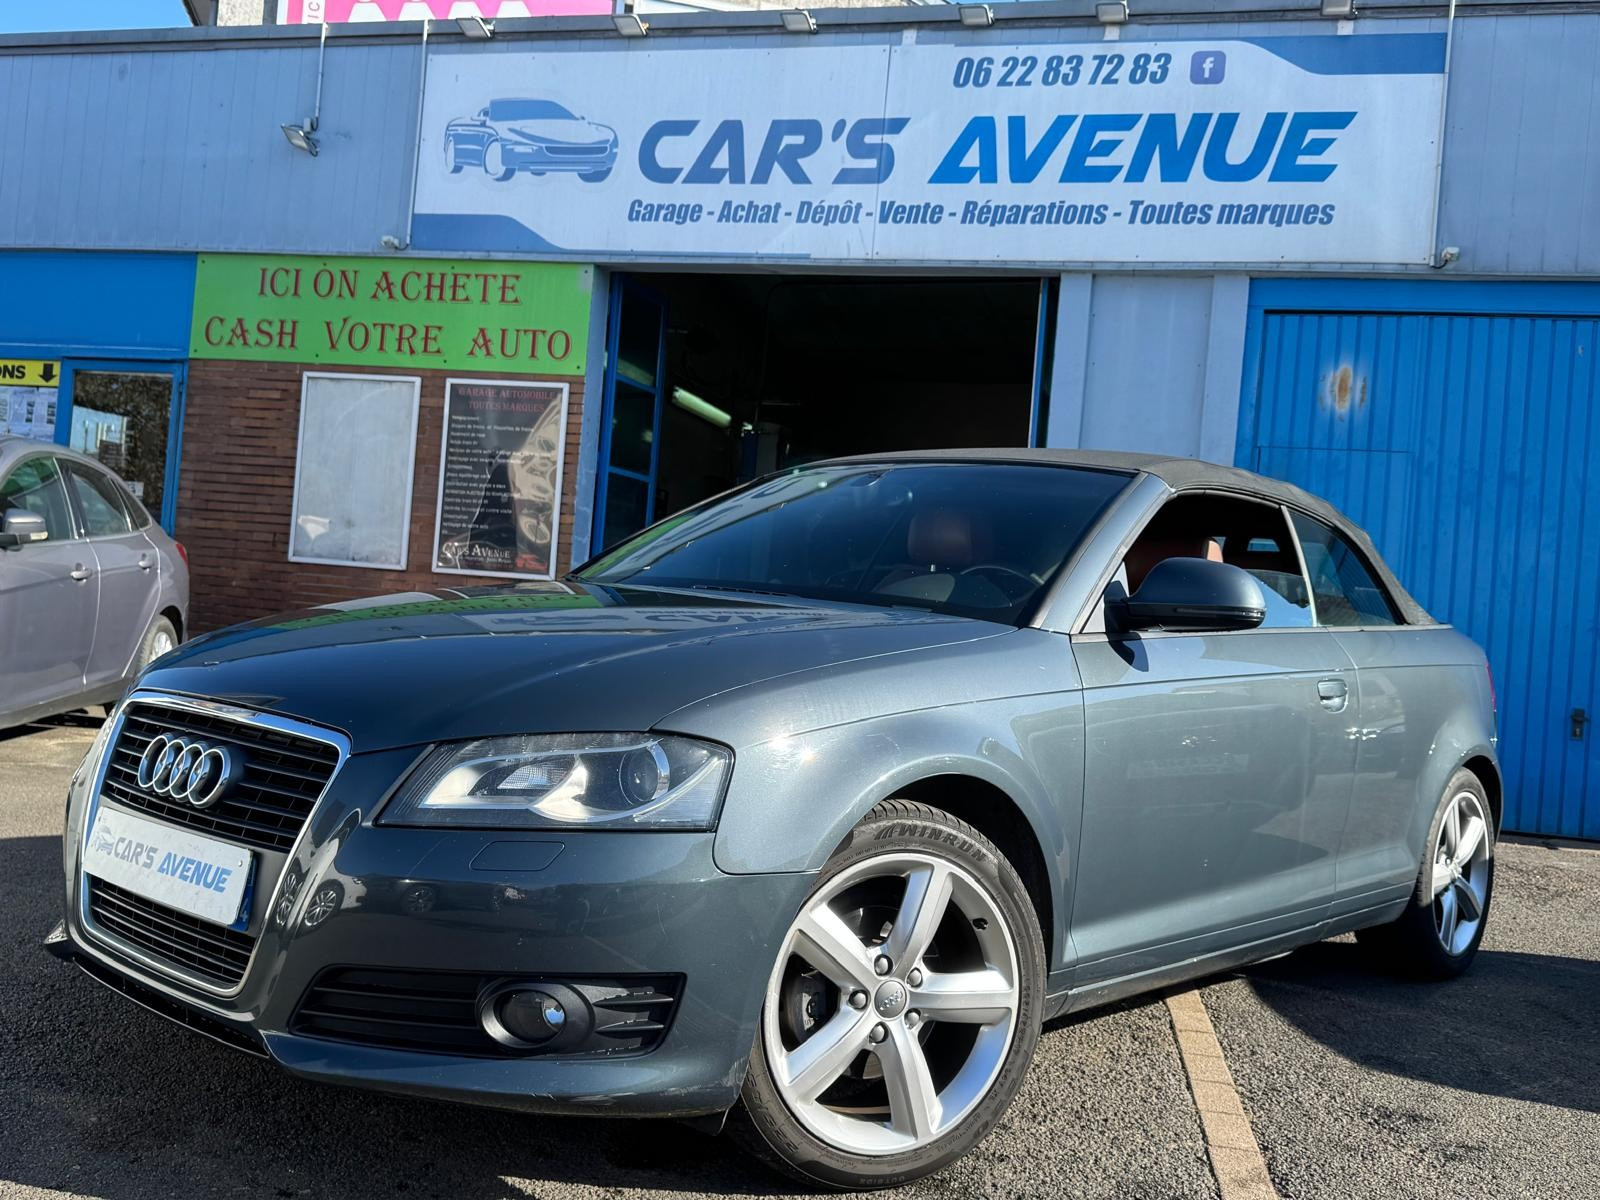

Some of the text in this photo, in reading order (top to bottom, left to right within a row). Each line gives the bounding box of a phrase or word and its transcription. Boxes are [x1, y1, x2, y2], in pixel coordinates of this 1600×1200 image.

[952, 53, 1172, 88] 06 22 83 72 83
[637, 111, 1358, 185] CAR'S AVENUE
[627, 199, 702, 224] Garage
[717, 201, 781, 224] Achat
[796, 200, 862, 227] Dépôt
[878, 201, 943, 225] Vente
[961, 199, 1108, 227] Réparations
[1127, 200, 1211, 225] Toutes
[1217, 202, 1335, 227] marques
[258, 268, 521, 304] ICI ON ACHETE
[204, 316, 573, 361] CASH VOTRE AUTO
[115, 837, 233, 893] CAR'S AVENUE
